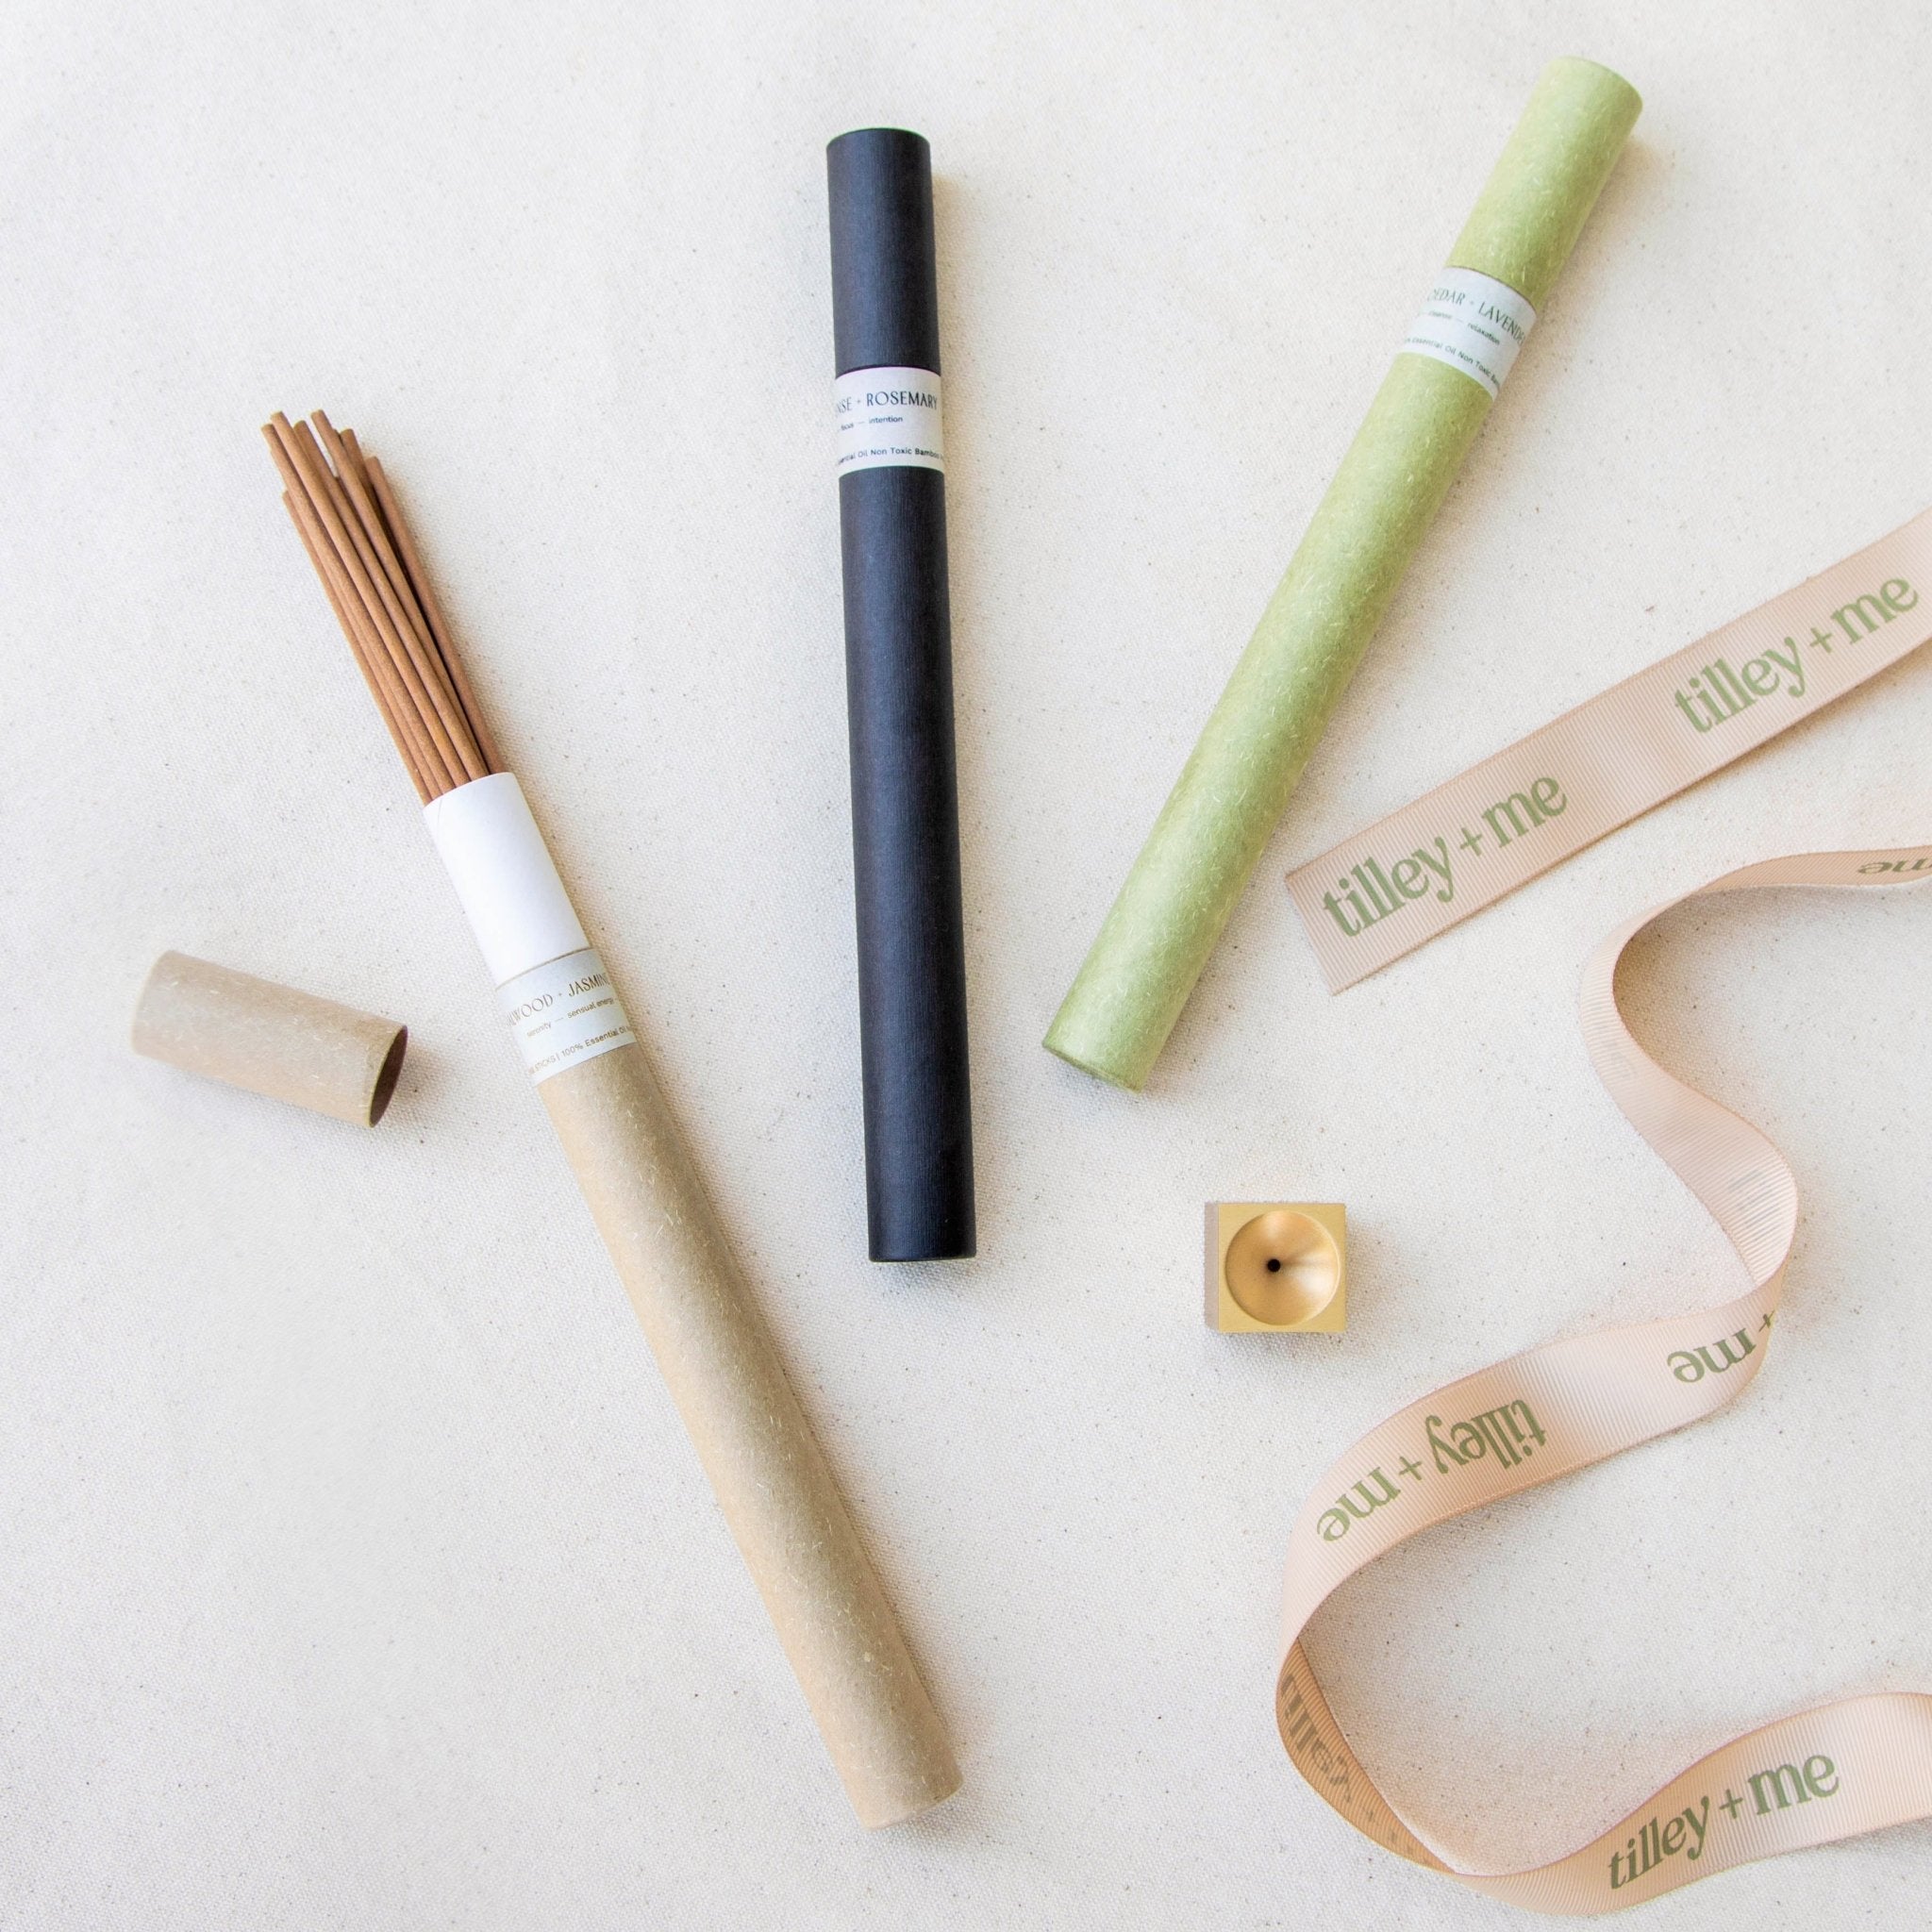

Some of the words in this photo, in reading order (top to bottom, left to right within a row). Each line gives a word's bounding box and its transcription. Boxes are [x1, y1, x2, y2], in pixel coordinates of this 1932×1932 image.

[1458, 351, 1474, 363] Non
[1475, 360, 1491, 377] Toxic
[866, 391, 938, 409] ROSEMARY
[869, 415, 903, 424] intention
[1674, 636, 1806, 733] tilley
[1830, 578, 1919, 644] me
[1323, 836, 1455, 937] tilley
[1481, 776, 1568, 848] me
[567, 1002, 595, 1018] sensual
[561, 1043, 583, 1058] 100%
[585, 1029, 619, 1047] Essential
[1667, 1327, 1757, 1383] me
[1425, 1399, 1546, 1474] tilley
[1317, 1467, 1401, 1541] me
[1608, 1796, 1709, 1890] tilley
[1748, 1755, 1839, 1815] me
